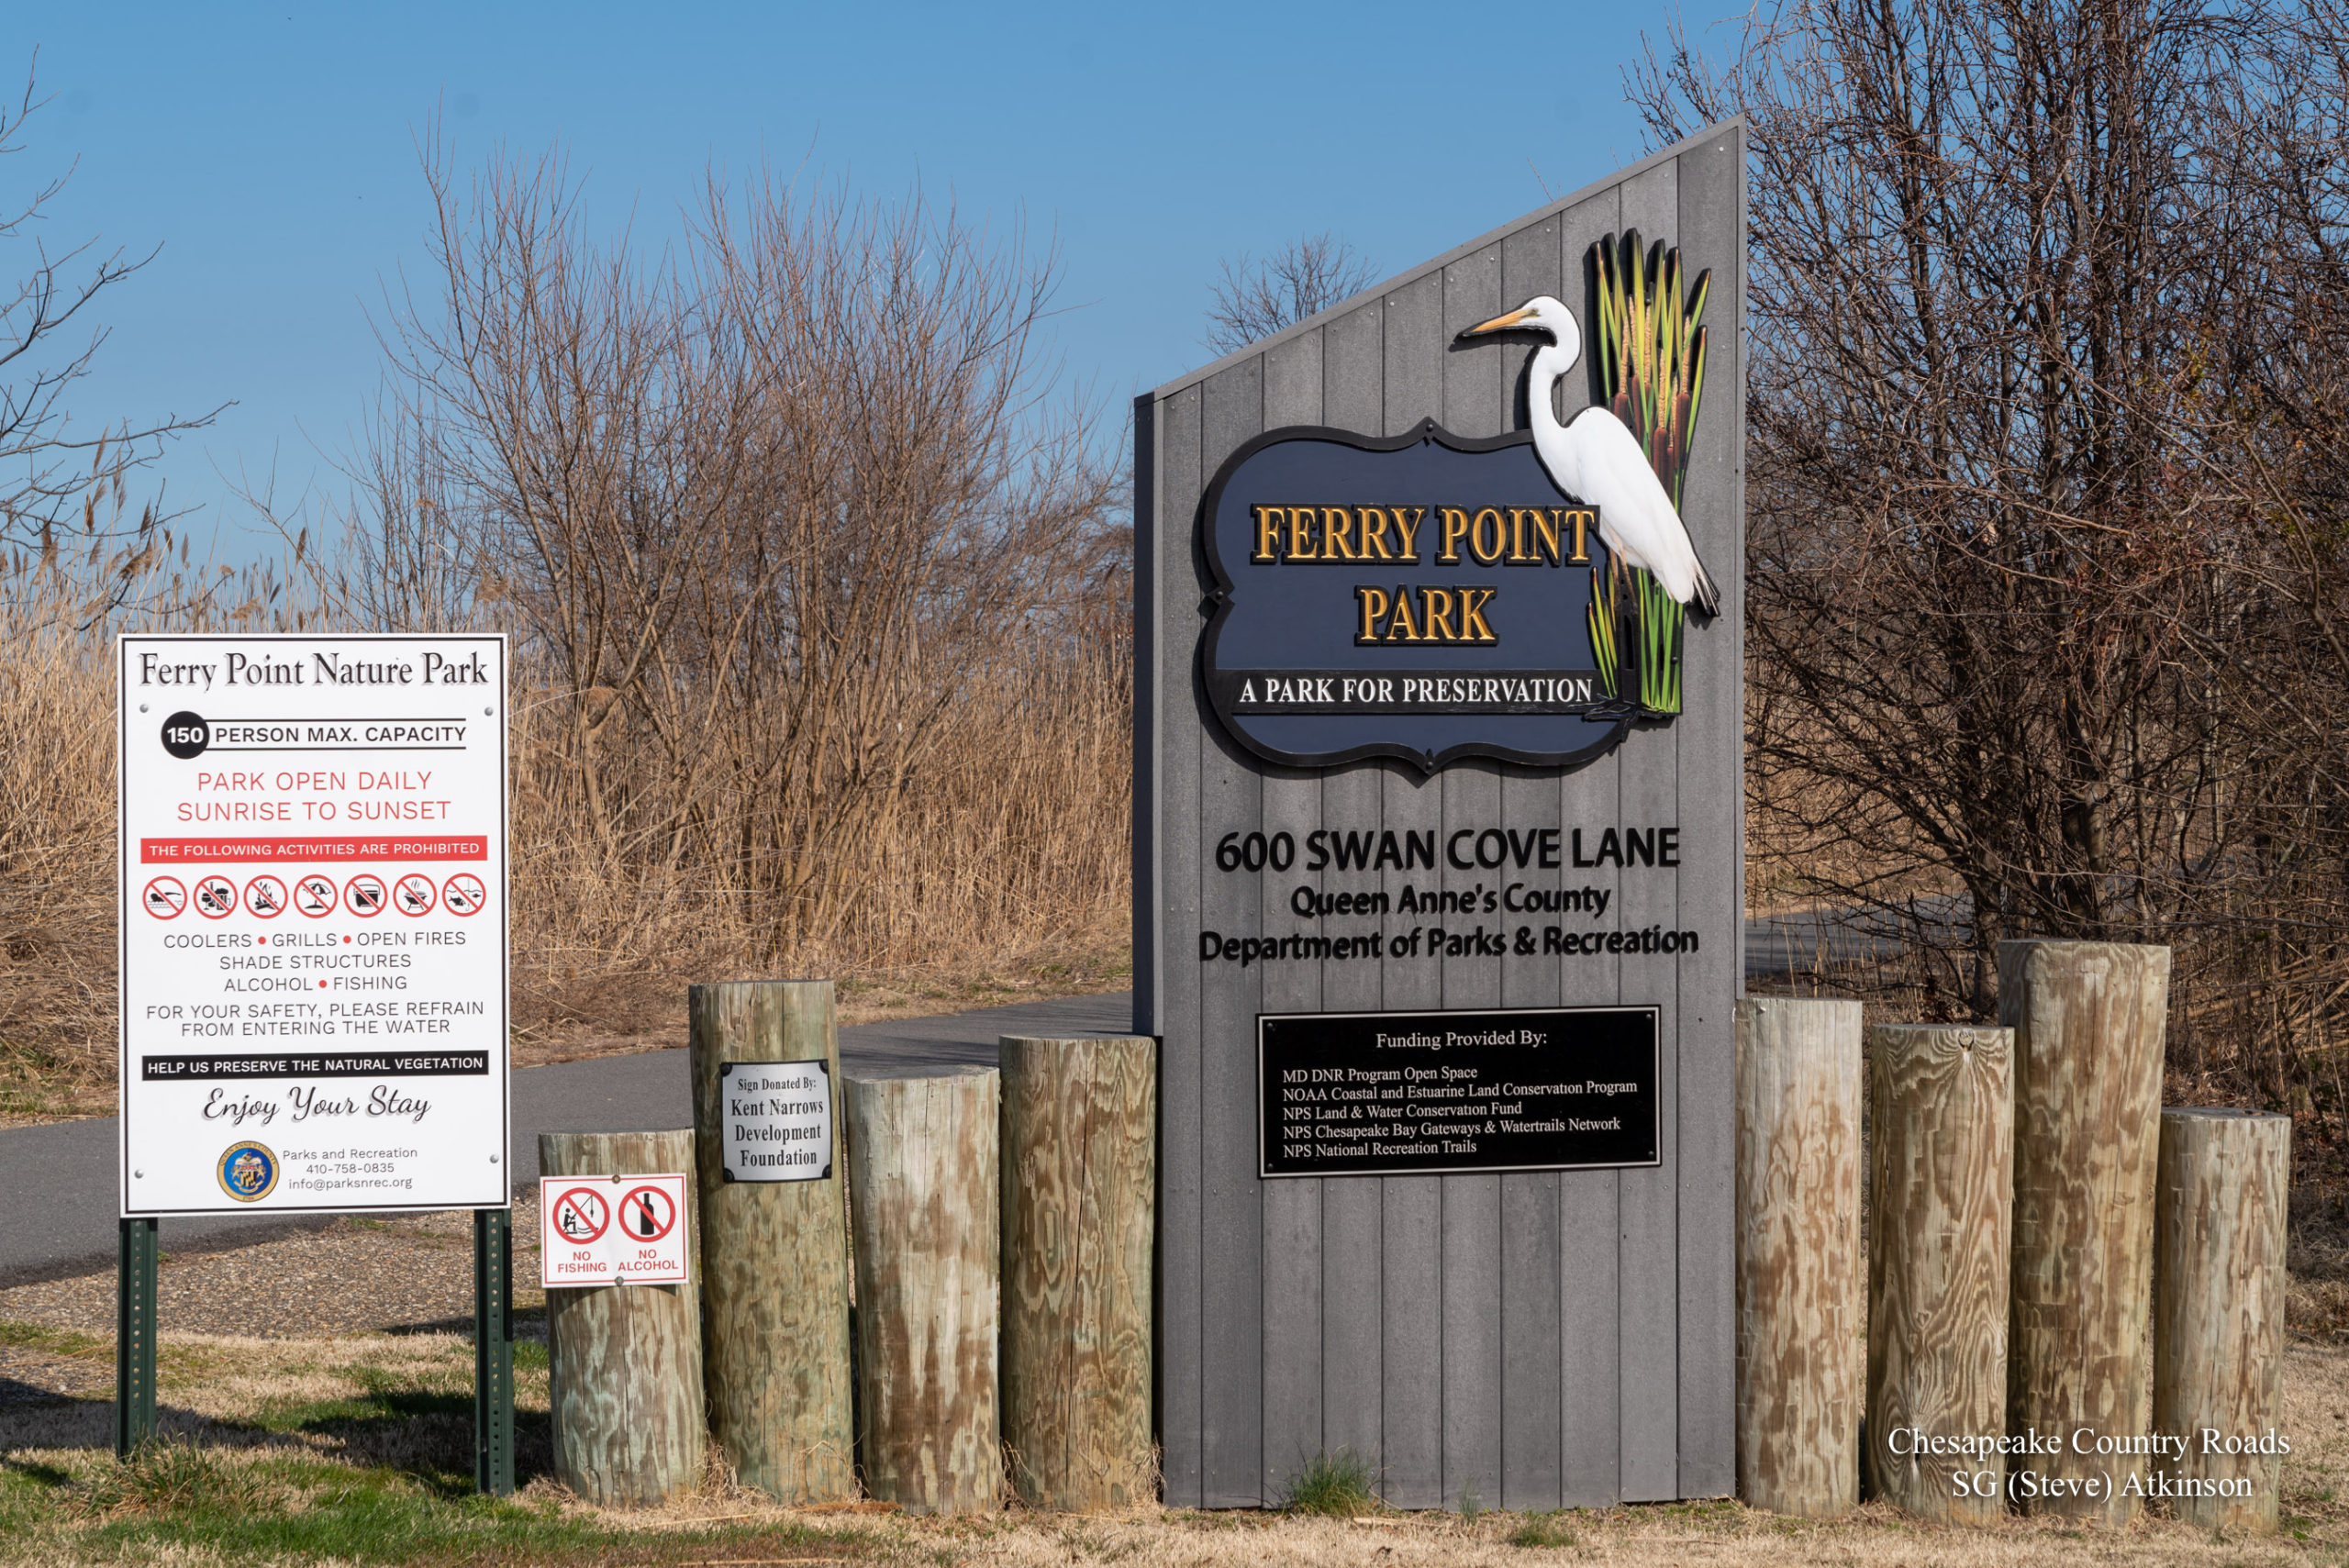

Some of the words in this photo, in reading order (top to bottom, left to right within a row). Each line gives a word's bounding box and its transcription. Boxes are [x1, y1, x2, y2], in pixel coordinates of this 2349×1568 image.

[1253, 505, 1427, 562] FERRY
[1438, 506, 1598, 562] POINT
[1357, 586, 1497, 642] PARK
[139, 653, 217, 692] Ferry
[226, 653, 304, 685] Point
[313, 652, 413, 685] Nature
[422, 651, 488, 684] Park
[1240, 679, 1257, 703] A
[1265, 679, 1335, 703] PARK
[1343, 679, 1394, 703] FOR
[1402, 678, 1593, 704] PRESERVATION
[167, 728, 204, 743] 150
[216, 728, 299, 742] PERSON
[308, 727, 358, 742] MAX.
[365, 726, 466, 741] CAPACITY
[198, 773, 264, 791] PARK
[276, 772, 345, 791] OPEN
[359, 772, 432, 790] DAILY
[177, 802, 291, 820] SUNRISE
[302, 802, 337, 820] TO
[347, 801, 451, 820] SUNSET
[150, 845, 179, 856] THE
[184, 844, 272, 856] FOLLOWING
[276, 843, 356, 855] ACTIVITIES
[362, 843, 388, 854] ARE
[394, 842, 479, 854] PROHIBITED
[1216, 831, 1296, 873] 600
[1306, 829, 1435, 871] SWAN
[1446, 828, 1561, 870] COVE
[1572, 827, 1681, 868] LANE
[1290, 885, 1389, 918] Queen
[1397, 884, 1497, 916] Anne's
[1503, 884, 1611, 918] County
[163, 934, 252, 949] COOLERS
[272, 933, 337, 947] GRILLS
[357, 933, 406, 946] OPEN
[415, 932, 466, 945] FIRES
[1199, 930, 1383, 967] Department
[1390, 927, 1422, 958] of
[1428, 926, 1508, 957] Parks
[1513, 928, 1535, 954] &
[1542, 925, 1699, 955] Recreation
[220, 956, 283, 970] SHADE
[289, 954, 411, 969] STRUCTURES
[224, 977, 313, 992] ALCOHOL
[333, 976, 407, 990] FISHING
[147, 1006, 184, 1019] FOR
[191, 1005, 240, 1018] YOUR
[248, 1004, 323, 1020] SAFETY,
[329, 1003, 398, 1017] PLEASE
[406, 1002, 484, 1015] REFRAIN
[181, 1022, 234, 1037] FROM
[242, 1021, 335, 1036] ENTERING
[343, 1020, 378, 1034] THE
[386, 1019, 451, 1033] WATER
[1376, 1033, 1442, 1050] Funding
[1446, 1031, 1516, 1047] Provided
[1520, 1030, 1547, 1047] By:
[148, 1062, 185, 1073] HELP
[190, 1062, 209, 1073] US
[214, 1061, 287, 1073] PRESERVE
[292, 1061, 320, 1072] THE
[325, 1059, 390, 1071] NATURAL
[395, 1057, 483, 1070] VEGETATION
[1283, 1070, 1308, 1083] MD
[1311, 1069, 1344, 1082] DNR
[1348, 1069, 1401, 1084] Program
[1404, 1067, 1438, 1082] Open
[1441, 1066, 1478, 1080] Space
[738, 1079, 758, 1093] Sign
[762, 1078, 799, 1090] Donated
[803, 1077, 817, 1090] By:
[1283, 1088, 1328, 1102] NOAA
[1331, 1086, 1377, 1100] Coastal
[1381, 1086, 1403, 1099] and
[1408, 1085, 1464, 1098] Estuarine
[1468, 1084, 1499, 1096] Land
[1503, 1081, 1583, 1095] Conservation
[1586, 1080, 1637, 1095] Program
[202, 1087, 280, 1126] Enjoy
[288, 1086, 359, 1122] Your
[367, 1084, 431, 1123] Stay
[731, 1098, 764, 1117] Kent
[770, 1098, 823, 1115] Narrows
[1283, 1106, 1311, 1120] NPS
[1316, 1106, 1347, 1118] Land
[1351, 1106, 1363, 1118] &
[1366, 1105, 1403, 1118] Water
[1406, 1103, 1487, 1117] Conservation
[1490, 1102, 1522, 1114] Fund
[735, 1123, 821, 1145] Development
[1283, 1126, 1311, 1139] NPS
[1315, 1123, 1388, 1140] Chesapeake
[1392, 1123, 1418, 1139] Bay
[1420, 1122, 1481, 1137] Gateways
[1485, 1120, 1497, 1133] &
[1499, 1118, 1565, 1132] Watertrails
[1568, 1118, 1620, 1130] Network
[283, 1151, 317, 1160] Parks
[321, 1149, 345, 1160] and
[351, 1148, 417, 1159] Recreation
[1283, 1144, 1311, 1158] NPS
[1316, 1142, 1369, 1156] National
[1372, 1140, 1438, 1155] Recreation
[1442, 1140, 1477, 1153] Trails
[740, 1150, 817, 1167] Foundation
[306, 1162, 395, 1174] 410-758-0835
[288, 1177, 412, 1191] info@parksnrec.org
[573, 1251, 591, 1262] NO
[639, 1250, 657, 1259] NO
[558, 1262, 607, 1273] FISHING
[618, 1261, 678, 1271] ALCOHOL
